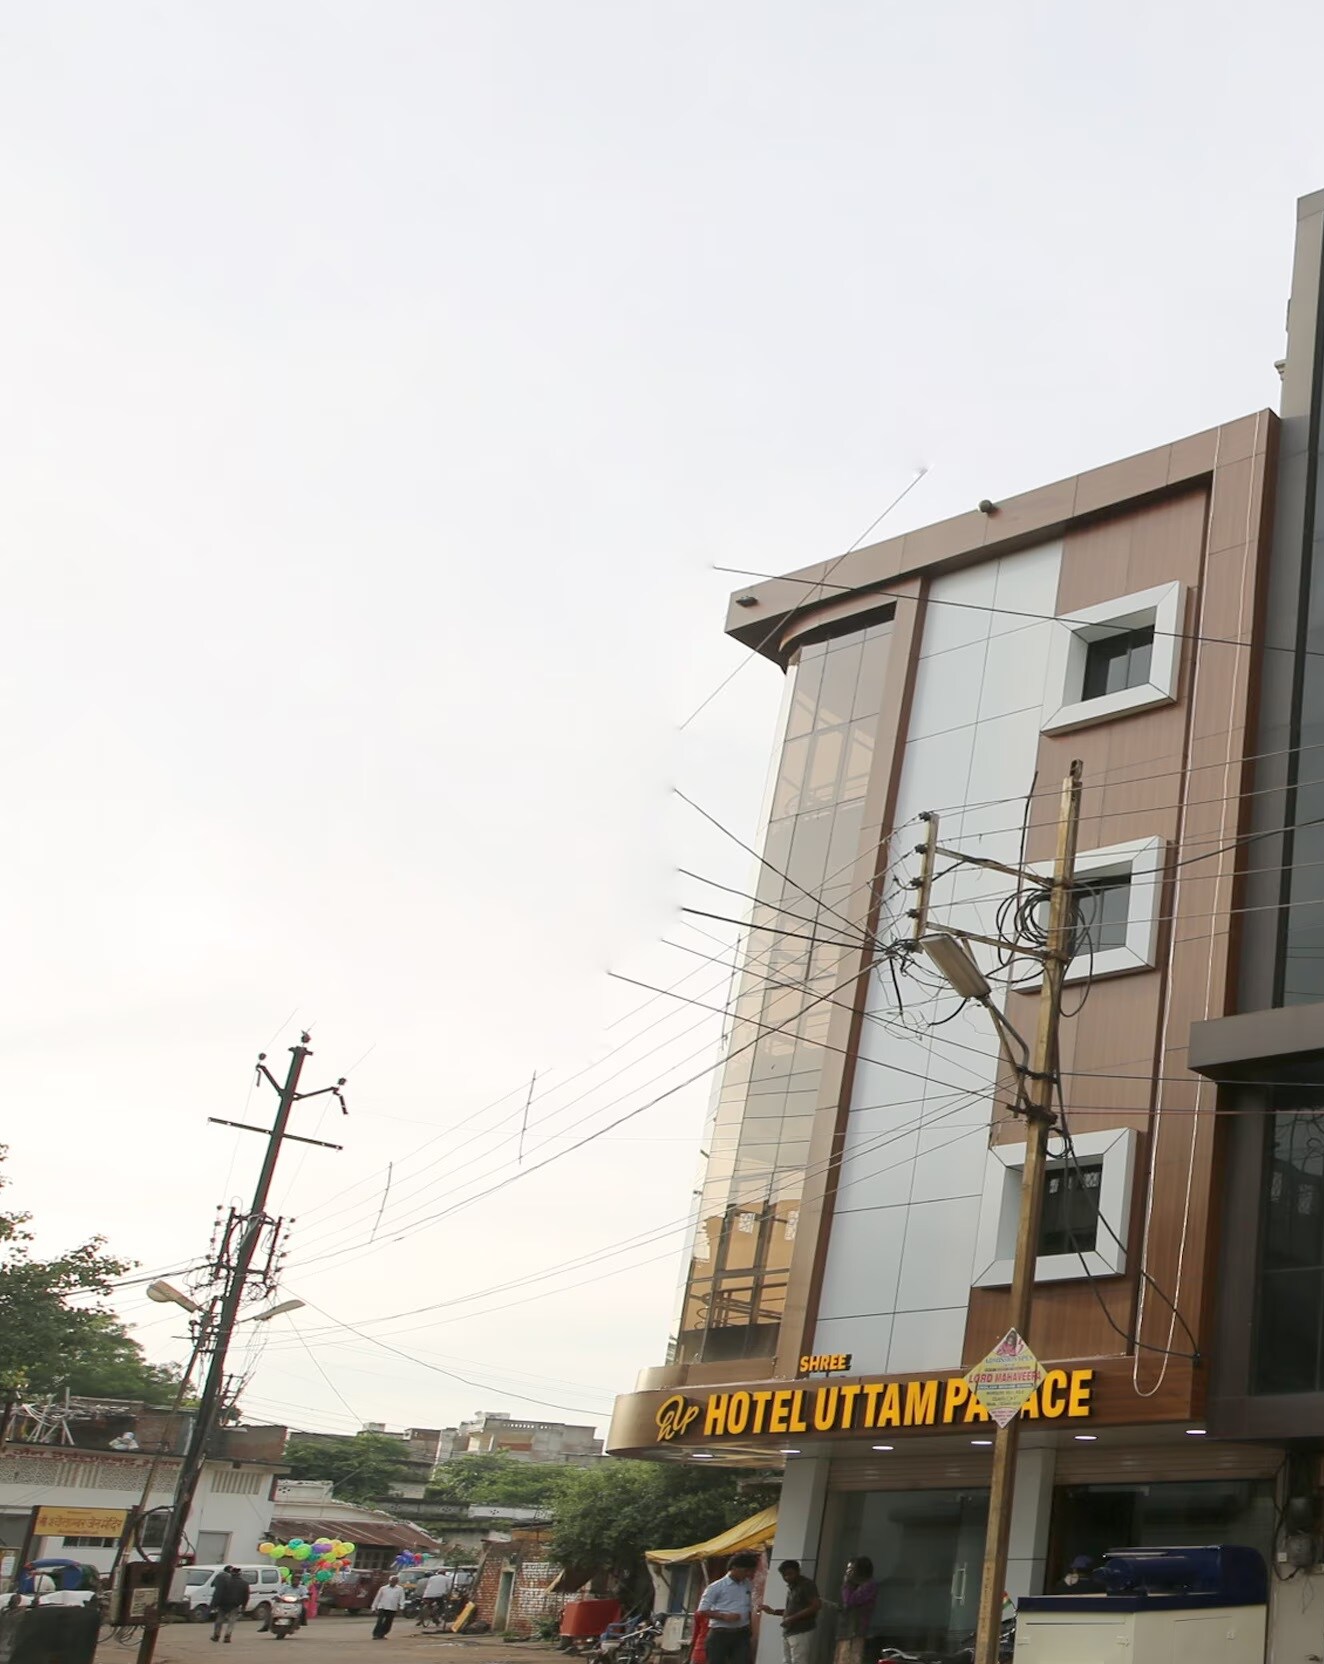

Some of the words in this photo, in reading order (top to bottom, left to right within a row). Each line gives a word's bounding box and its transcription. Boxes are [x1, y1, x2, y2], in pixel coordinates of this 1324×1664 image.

[800, 1353, 848, 1373] SHREE
[969, 1374, 992, 1383] LORD
[703, 1389, 807, 1436] HOTEL
[814, 1380, 939, 1431] UTTAM
[943, 1369, 1093, 1423] PAACE
